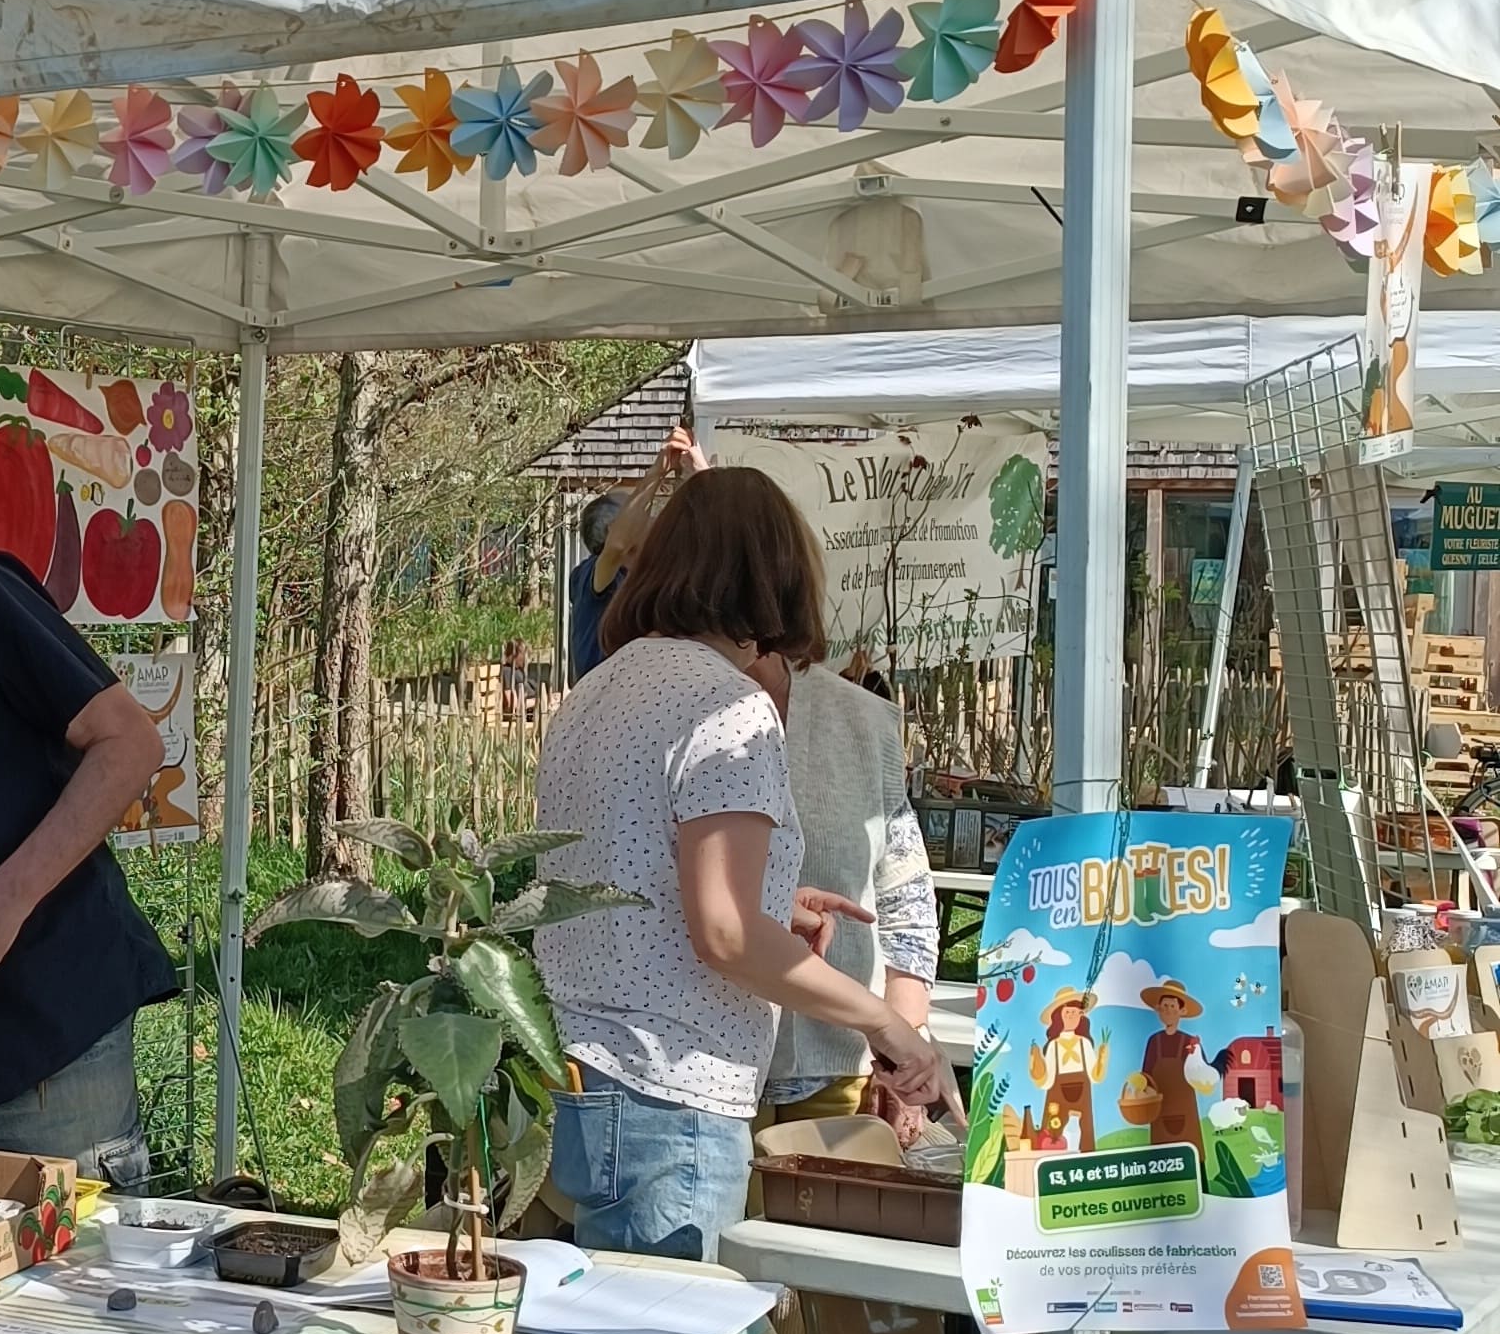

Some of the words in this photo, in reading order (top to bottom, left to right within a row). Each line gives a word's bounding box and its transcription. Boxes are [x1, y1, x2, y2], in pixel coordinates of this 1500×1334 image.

[1467, 486, 1484, 504] AU
[137, 665, 169, 682] AMAP
[1031, 866, 1078, 907] TOUS
[1053, 906, 1079, 925] en
[1069, 1170, 1084, 1183] 14
[1087, 1167, 1102, 1181] et
[1103, 1165, 1118, 1180] 15
[1120, 1161, 1146, 1180] juin
[1149, 1157, 1185, 1173] 2025
[1051, 1199, 1108, 1220] Portes
[1112, 1193, 1186, 1213] ouvertes
[1006, 1247, 1066, 1261] Découvrez
[1068, 1246, 1087, 1258] les
[1089, 1245, 1146, 1258] coulisses
[1148, 1245, 1164, 1257] de
[1166, 1244, 1237, 1258] fabrication
[1039, 1264, 1055, 1277] de
[1057, 1265, 1081, 1276] vos
[1084, 1263, 1139, 1277] produits
[1141, 1263, 1197, 1276] préférés
